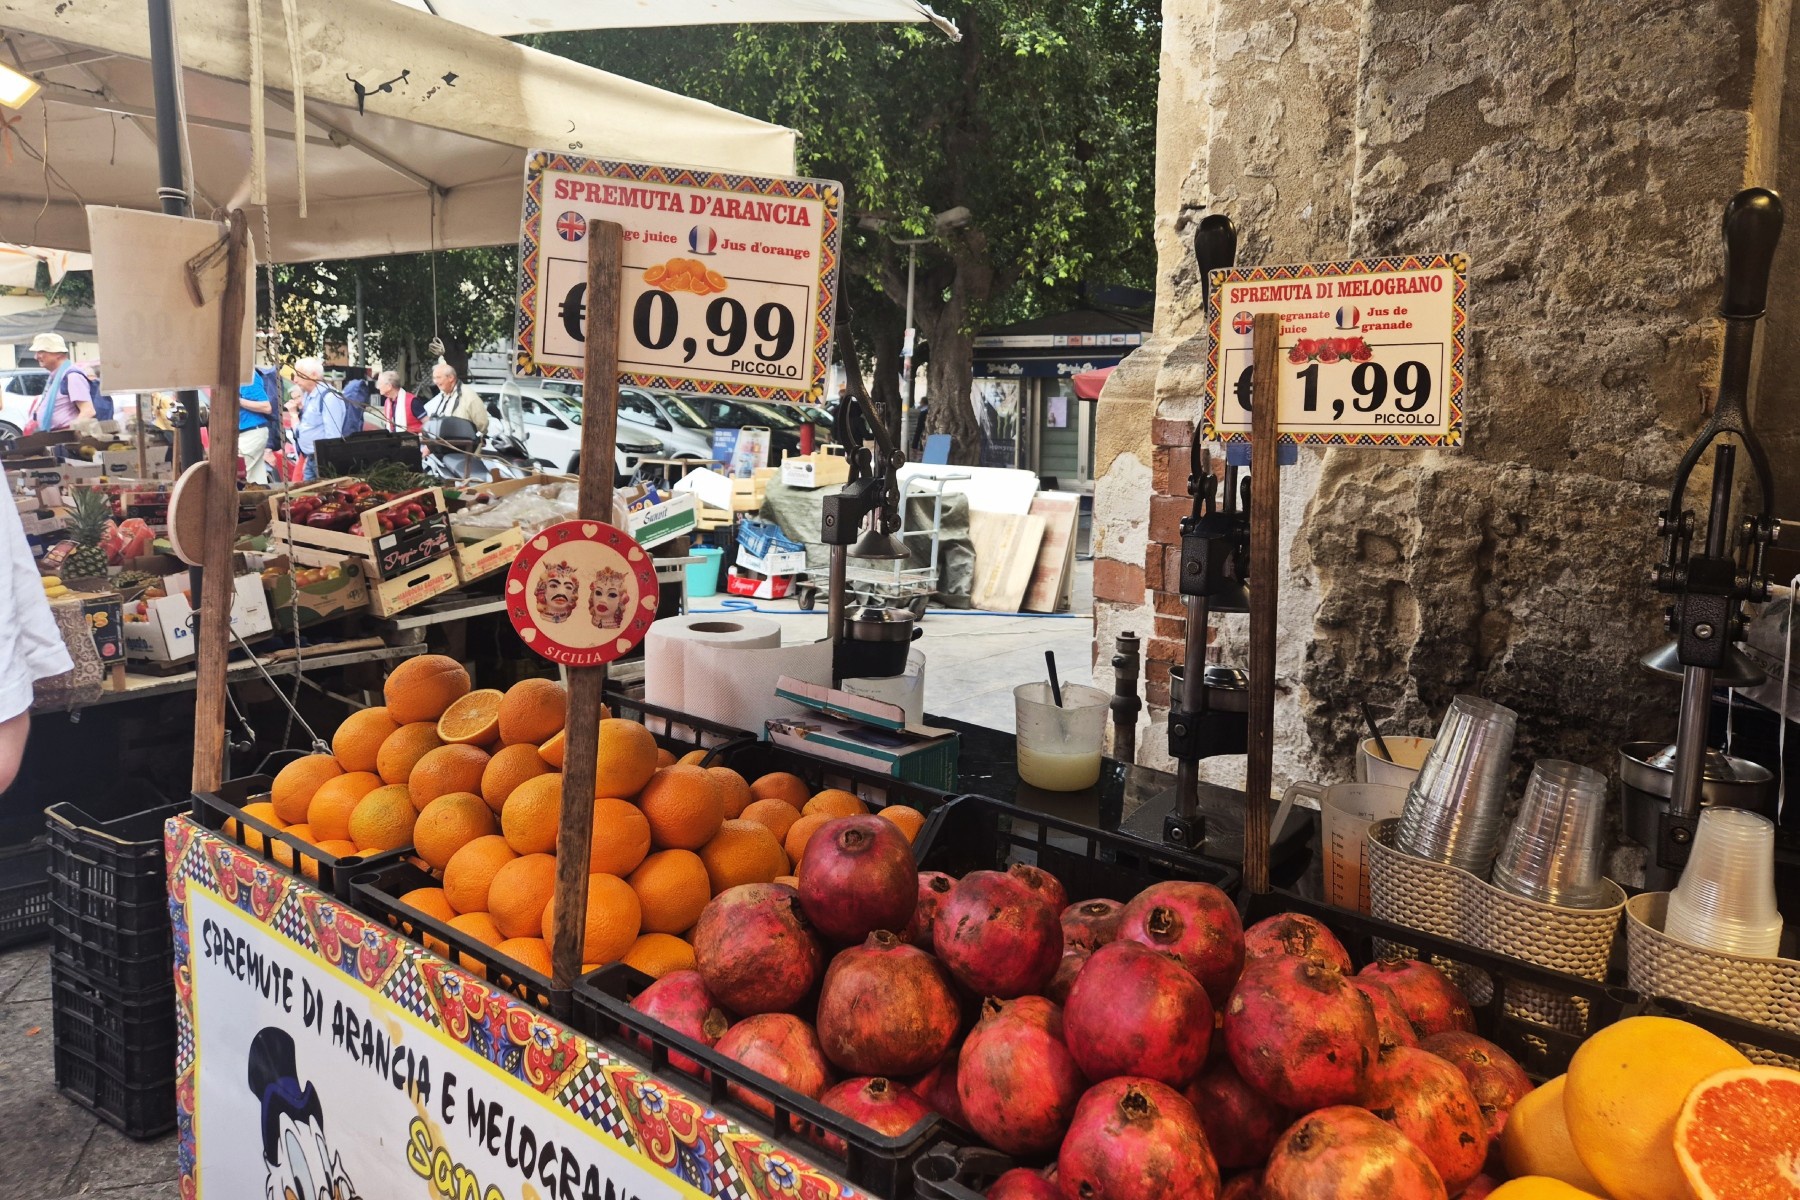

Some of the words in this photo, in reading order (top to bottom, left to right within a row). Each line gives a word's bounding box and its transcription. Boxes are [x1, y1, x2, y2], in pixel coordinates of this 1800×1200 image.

[555, 178, 685, 213] SPREMUTA
[690, 194, 811, 227] D'ARANCIA
[642, 230, 677, 243] juice
[721, 239, 747, 252] Jus
[751, 242, 811, 260] d'orange
[1230, 284, 1313, 304] SPREMUTA
[1316, 282, 1333, 299] DI
[1338, 274, 1443, 298] MELOGRANO
[1367, 307, 1389, 318] Jus
[1393, 306, 1408, 316] de
[633, 289, 795, 364] 0,99
[1280, 325, 1307, 336] juice
[1361, 319, 1413, 333] granade
[731, 359, 798, 377] PICCOLO
[1296, 360, 1432, 421] 1,99
[1374, 413, 1435, 425] PICCOLO
[544, 646, 602, 664] SICILIA
[202, 918, 294, 1013] SPREMUTE
[302, 976, 324, 1036] DI
[331, 1000, 431, 1107] ARANCIA
[441, 1072, 457, 1124] E
